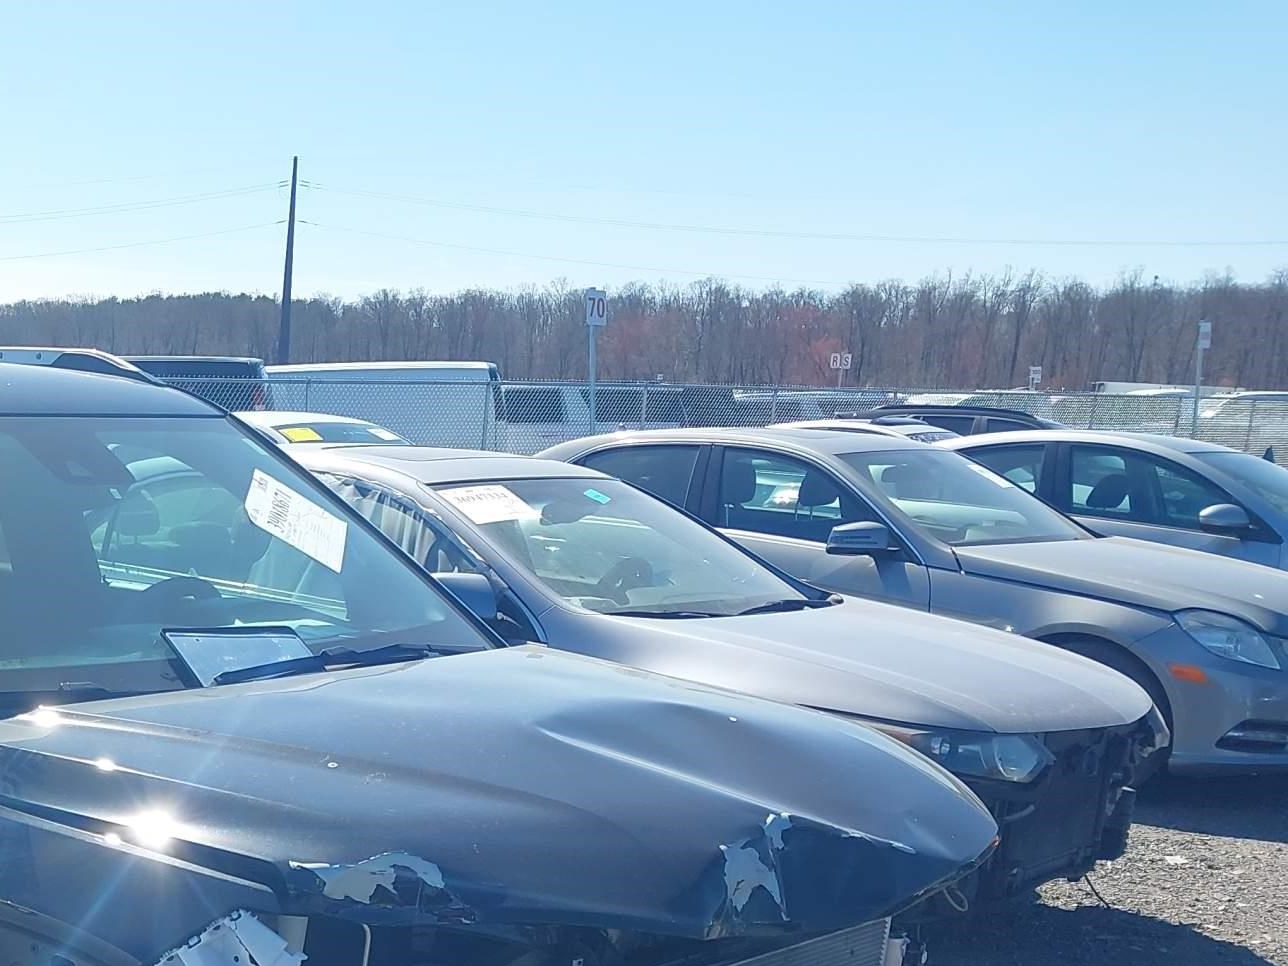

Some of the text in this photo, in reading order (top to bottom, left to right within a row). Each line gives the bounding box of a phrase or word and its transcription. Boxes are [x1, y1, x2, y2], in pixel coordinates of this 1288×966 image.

[588, 297, 605, 318] 70
[832, 355, 839, 367] R
[843, 356, 850, 367] S
